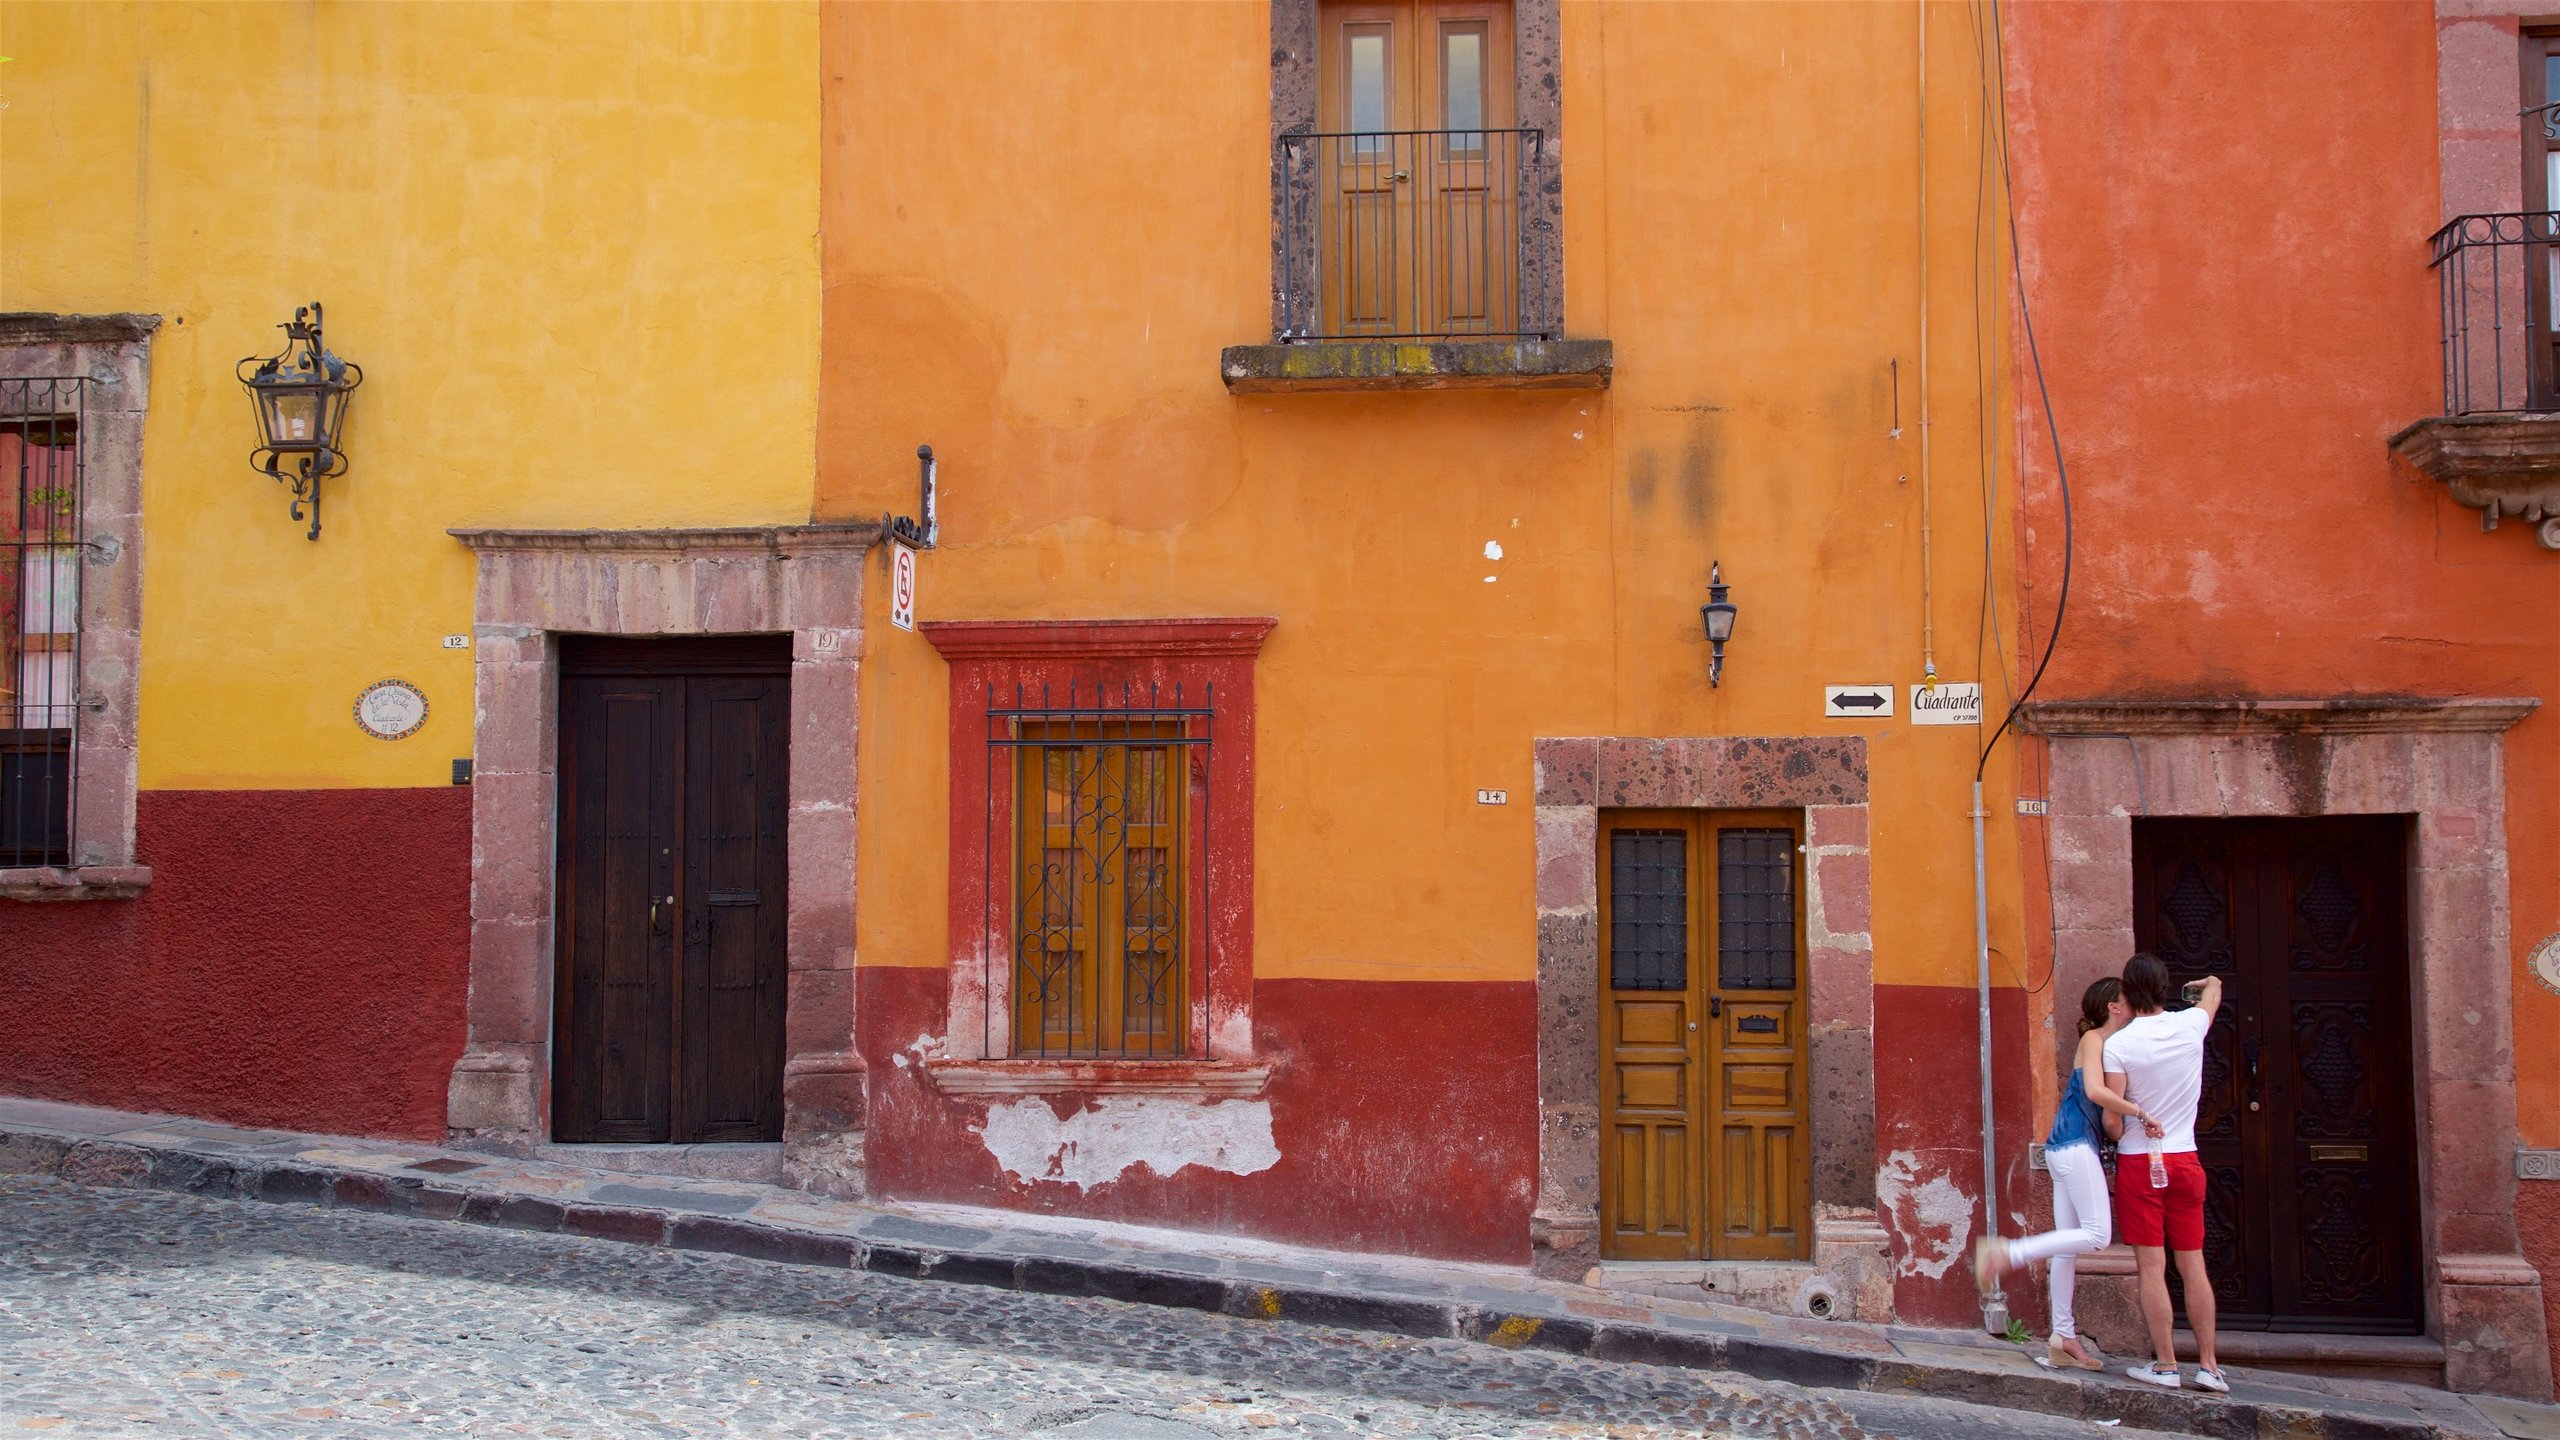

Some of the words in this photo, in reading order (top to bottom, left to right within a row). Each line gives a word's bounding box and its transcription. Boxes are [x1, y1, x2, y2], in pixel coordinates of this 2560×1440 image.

[450, 636, 462, 646] 12
[818, 631, 832, 648] 19
[1914, 686, 1979, 710] Cuadrante
[2025, 802, 2040, 812] 16
